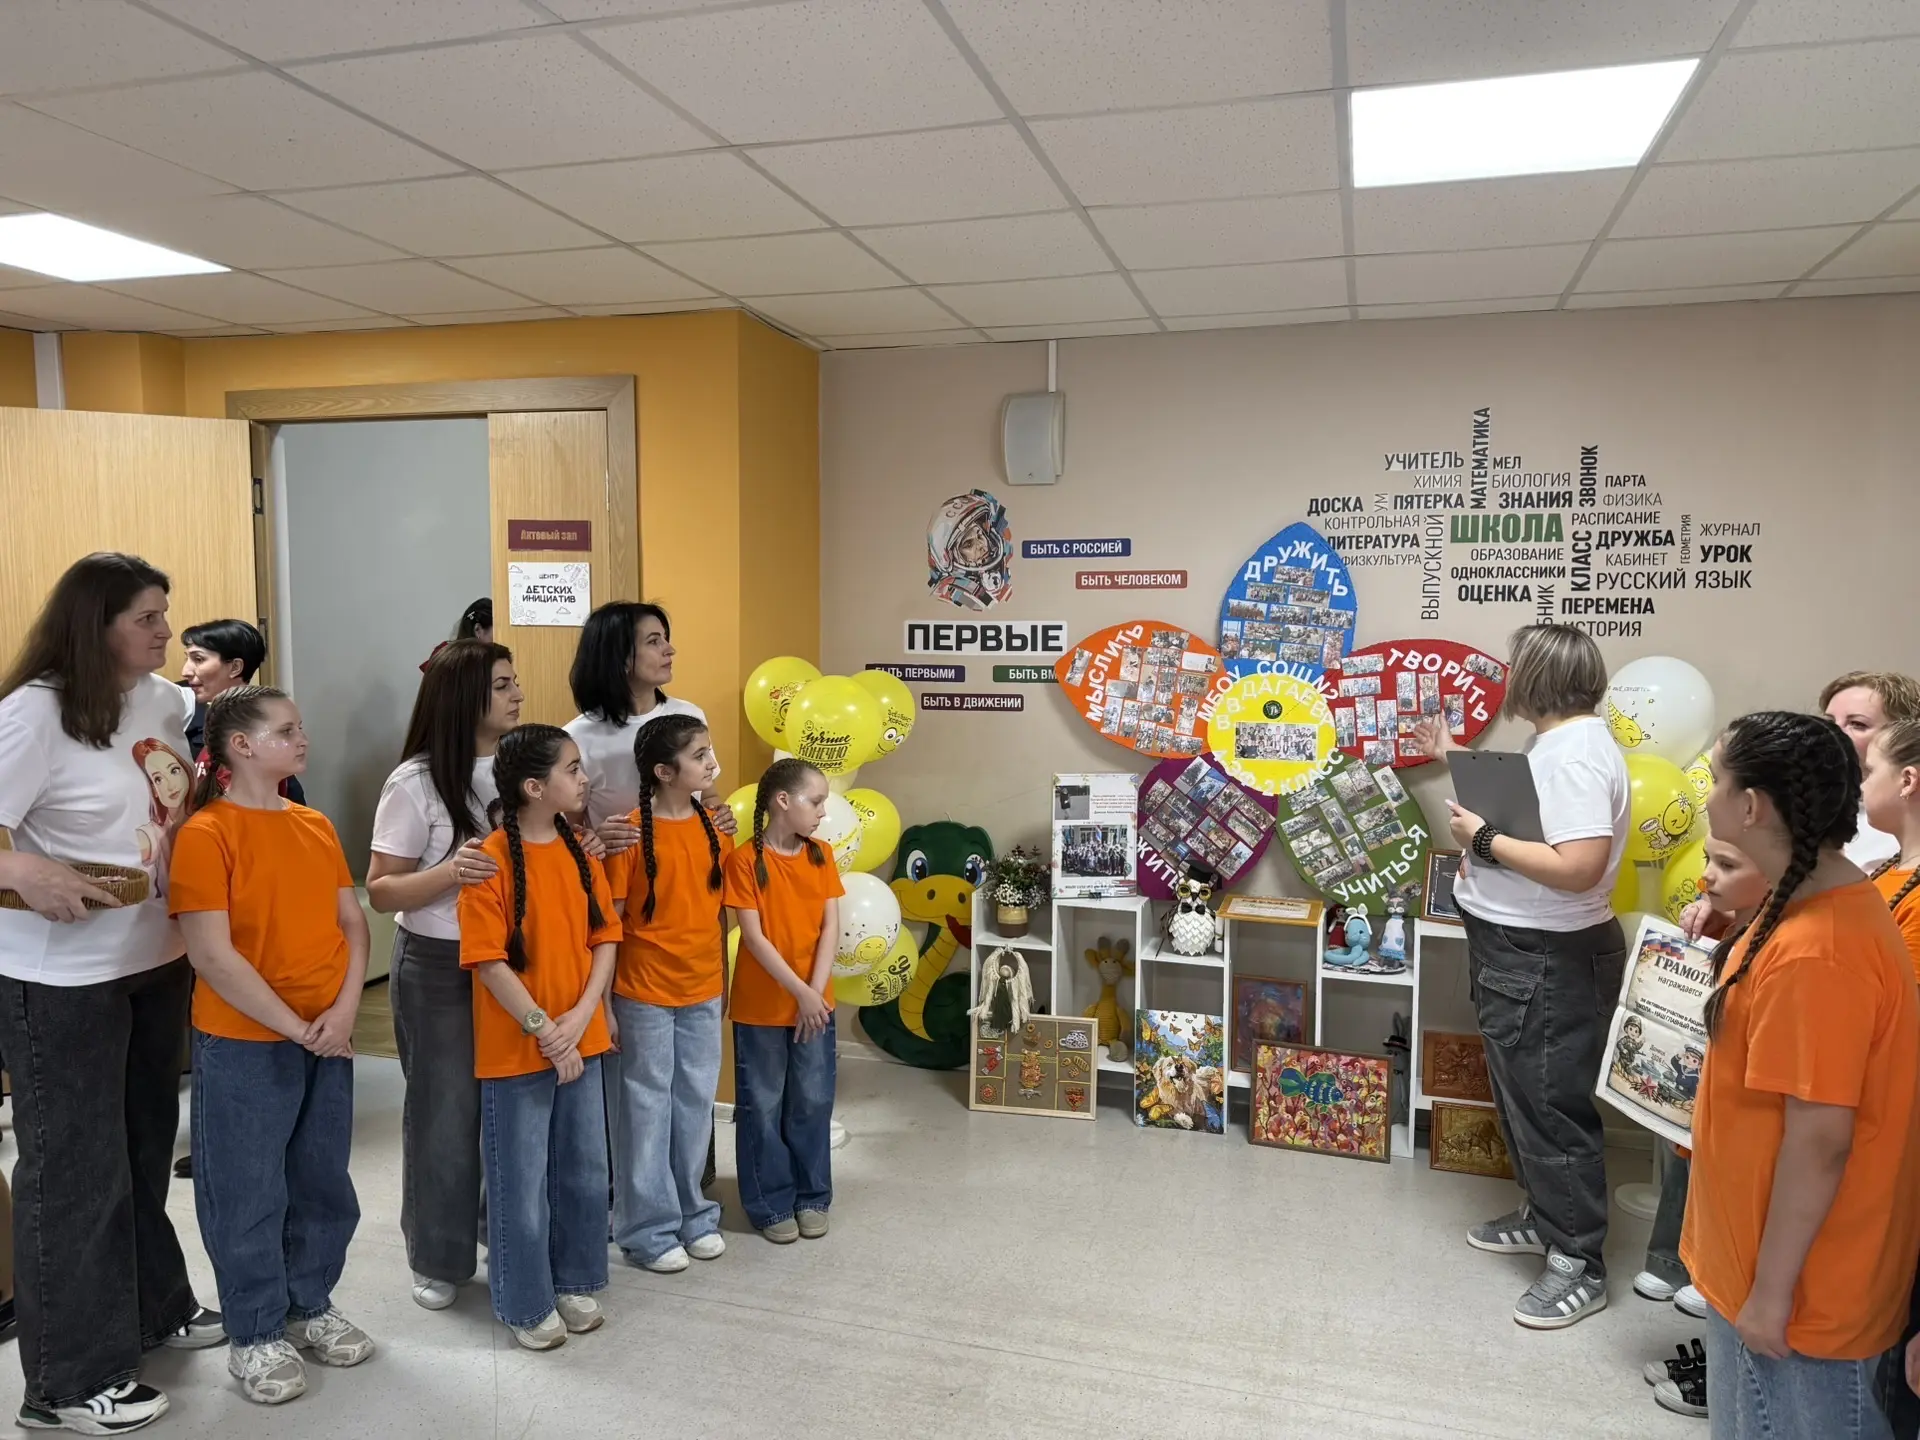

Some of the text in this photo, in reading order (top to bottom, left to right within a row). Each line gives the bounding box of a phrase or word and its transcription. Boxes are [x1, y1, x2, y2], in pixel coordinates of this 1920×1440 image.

[1384, 451, 1465, 471] УЧИТЕЛЬ
[1470, 406, 1491, 510] МАТЕМАТИКА
[1493, 456, 1522, 470] МЕЛ
[1413, 474, 1462, 489] ХИМИЯ
[1492, 472, 1571, 489] БИОЛОГИЯ
[1578, 445, 1598, 508] ЗВОНОК
[1605, 474, 1647, 488] ПАРТА
[1307, 496, 1364, 517] ДОСКА
[1374, 493, 1388, 513] УМ
[1393, 493, 1465, 510] ПЯТЕРКА
[1498, 491, 1573, 509] ЗНАНИЯ
[1602, 492, 1663, 507] ФИЗИКА
[1324, 514, 1420, 531] КОНТРОЛЬНАЯ
[1571, 511, 1661, 526] РАСПИСАНИЕ
[521, 529, 578, 541] Актовый зал
[1450, 513, 1564, 544] ШКОЛА
[1699, 523, 1761, 537] ЖУРНАЛ
[1030, 540, 1122, 555] БЫТЬ С РОССИЕЙ
[1327, 533, 1421, 551] ЛИТЕРАТУРА
[1595, 530, 1676, 551] ДРУЖБА
[1680, 514, 1691, 564] ГЕОМЕТРИЯ
[1470, 548, 1564, 561] ОБРАЗОВАНИЕ
[1571, 530, 1592, 592] КЛАСС
[1605, 552, 1668, 567] КАБИНЕТ
[1700, 544, 1753, 563] УРОК
[1244, 540, 1349, 597] ДРУЖИТЬ
[1421, 514, 1444, 620] ВЫПУСКНОЙ
[1451, 566, 1566, 580] ОДНОКЛАССНИКИ
[1081, 573, 1182, 586] БЫТЬ ЧЕЛОВЕКОМ
[1596, 568, 1753, 590] РУССКИЙ ЯЗЫК
[526, 586, 573, 594] ДЕТСКИХ
[1457, 584, 1533, 605] ОЦЕНКА
[522, 595, 576, 604] ИНИЦИАТИВ
[1561, 597, 1656, 615] ПЕРЕМЕНА
[908, 623, 1064, 652] ПЕРВЫЕ
[905, 667, 955, 679] ПЕРВЫМИ
[1009, 668, 1038, 680] БЫТЬ
[1085, 624, 1144, 723] МЫСЛИТЬ
[1196, 665, 1242, 723] МБОУ
[1256, 660, 1313, 685] СОШ
[1386, 648, 1490, 722] ТВОРИТЬ
[923, 696, 1022, 709] БЫТЬ В ДВИЖЕНИИ
[1241, 679, 1336, 728] ДАГАЕВА
[1279, 747, 1345, 797] КЛАСС
[1333, 824, 1429, 902] УЧИТЬСЯ
[1654, 955, 1714, 989] ГРАМОТА
[1657, 976, 1703, 998] награждается
